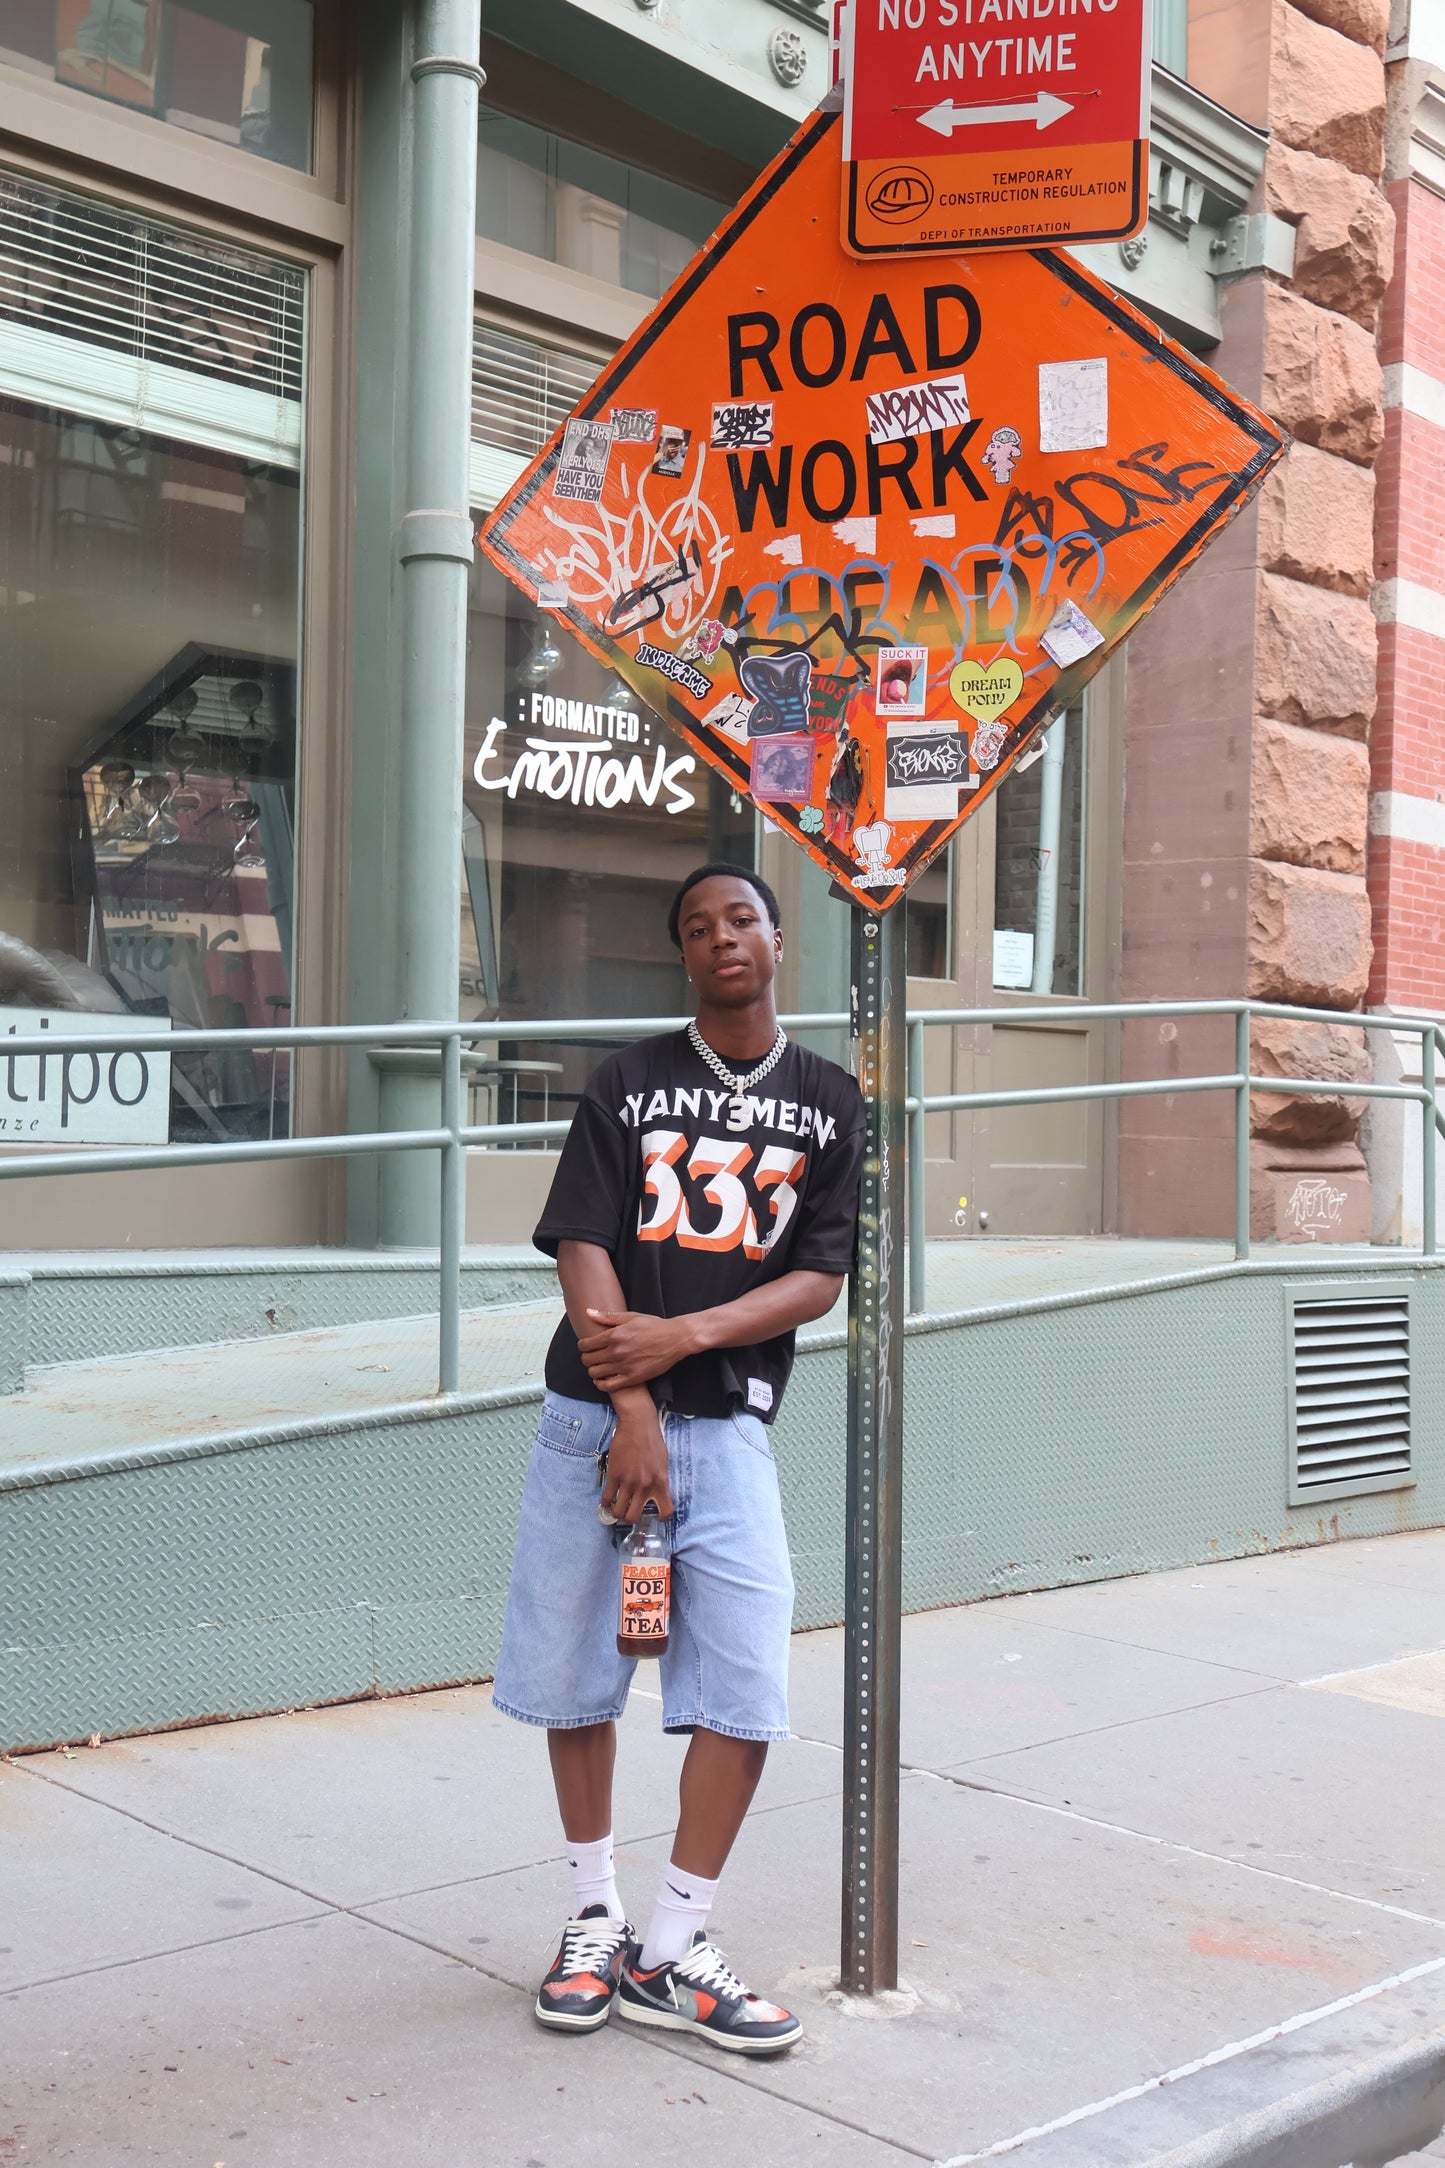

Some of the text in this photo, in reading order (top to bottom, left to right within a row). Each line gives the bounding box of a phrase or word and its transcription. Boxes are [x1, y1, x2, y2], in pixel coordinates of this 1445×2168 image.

[878, 0, 926, 31] NO
[915, 33, 1077, 83] ANYTIME
[993, 168, 1073, 186] TEMPORARY
[939, 181, 1127, 207] CONSTRUCTION REGULATION
[920, 222, 1071, 241] DEPT OF TRANSPORTATION
[727, 284, 982, 398] ROAD
[568, 421, 612, 441] END DHS
[557, 469, 605, 489] HAVE YOU
[726, 417, 989, 533] WORK
[714, 559, 1031, 663] AHEAD
[881, 649, 927, 659] SUCK IT
[961, 678, 1011, 692] DREAM
[967, 693, 1006, 707] PONY
[637, 1130, 807, 1261] 333
[623, 1565, 666, 1578] PEACH
[625, 1580, 664, 1596] JOE
[624, 1617, 664, 1634] TEA
